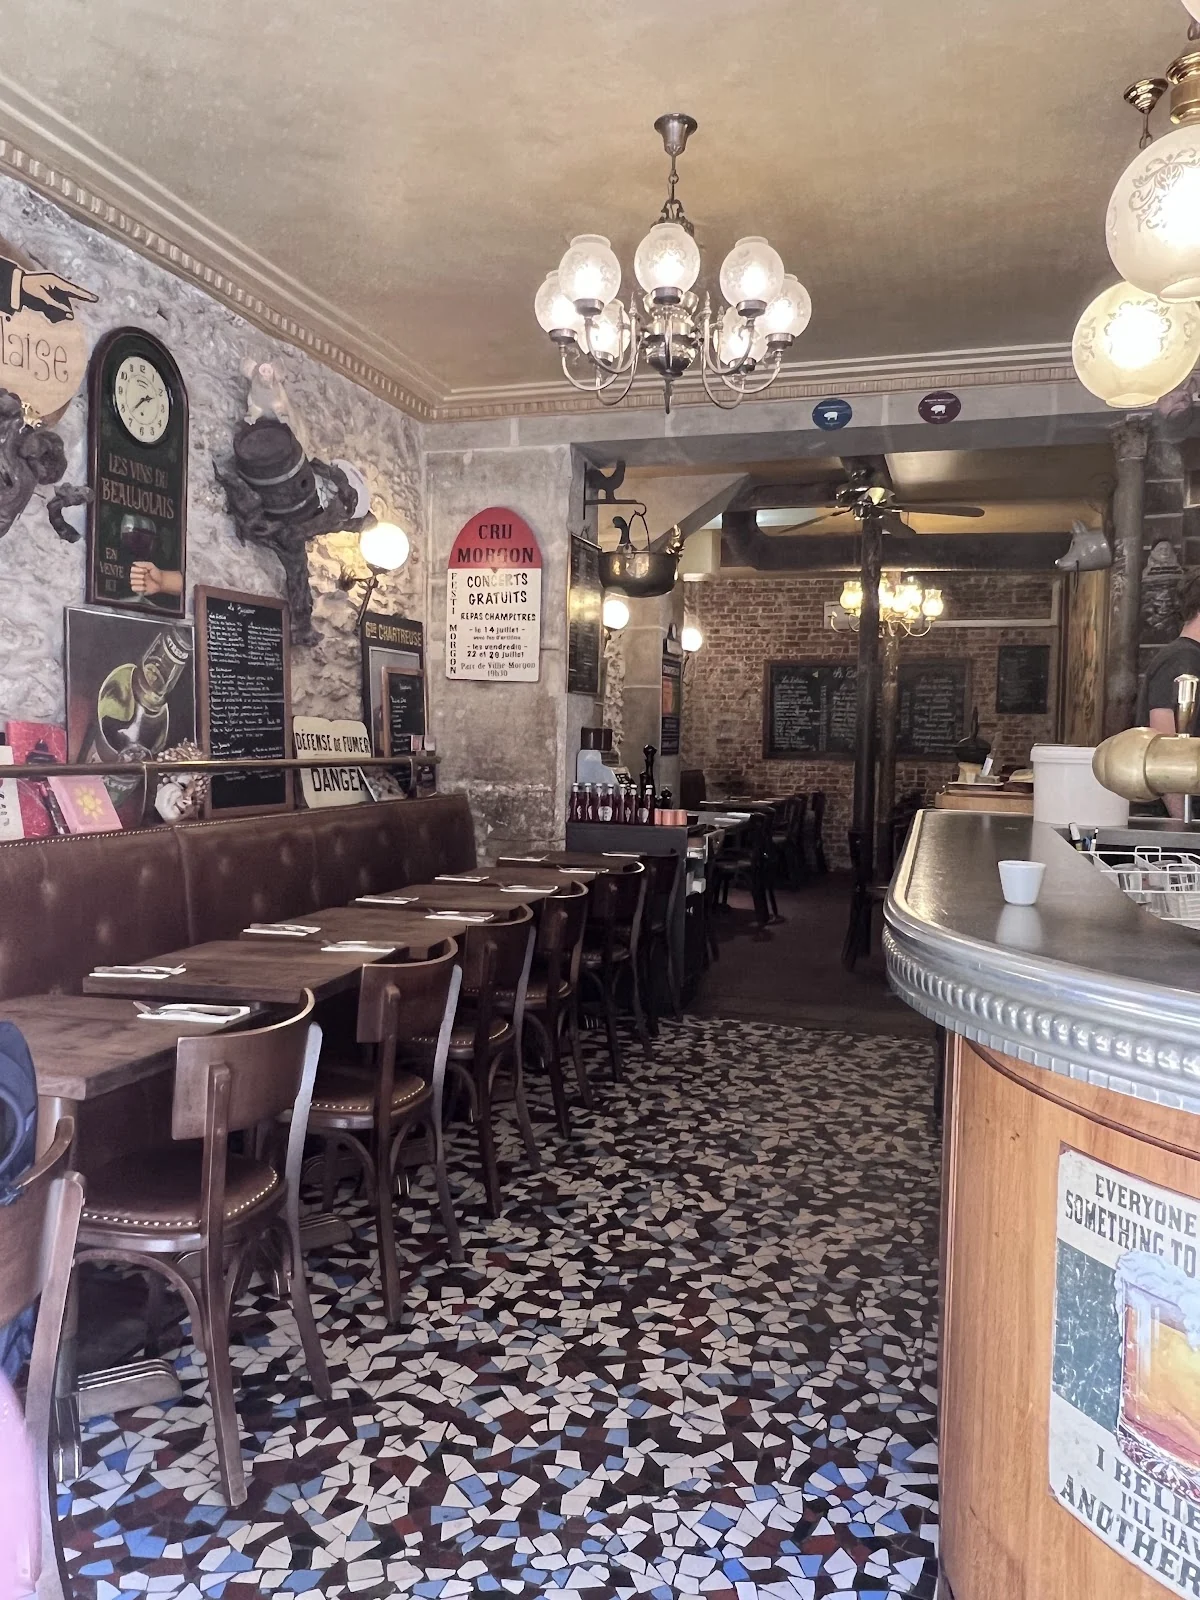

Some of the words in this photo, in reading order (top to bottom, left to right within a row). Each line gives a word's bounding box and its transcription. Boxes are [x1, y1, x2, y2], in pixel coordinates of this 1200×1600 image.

[108, 452, 128, 476] LES
[129, 460, 152, 484] VINS
[101, 477, 174, 519] BEAUJOLAIS
[478, 524, 512, 540] CRU
[105, 547, 117, 560] EN
[457, 547, 534, 563] MORGON
[467, 572, 528, 589] CONCERTS
[468, 590, 528, 606] GRATUITS
[460, 612, 484, 621] REPAS
[378, 623, 423, 647] CHARTREUSE
[484, 626, 495, 634] 14
[496, 626, 519, 635] juillet
[467, 650, 477, 658] 22
[501, 651, 525, 659] juillet
[477, 662, 486, 670] de
[295, 728, 333, 751] DÉFENSE
[342, 736, 371, 754] FUMER
[1095, 1173, 1198, 1238] EVERYONE
[1065, 1189, 1164, 1257] SOMETHING
[1171, 1238, 1197, 1279] TO
[1097, 1444, 1105, 1471] I
[1121, 1491, 1155, 1533] I'LL
[1060, 1474, 1200, 1598] ANOTHER
